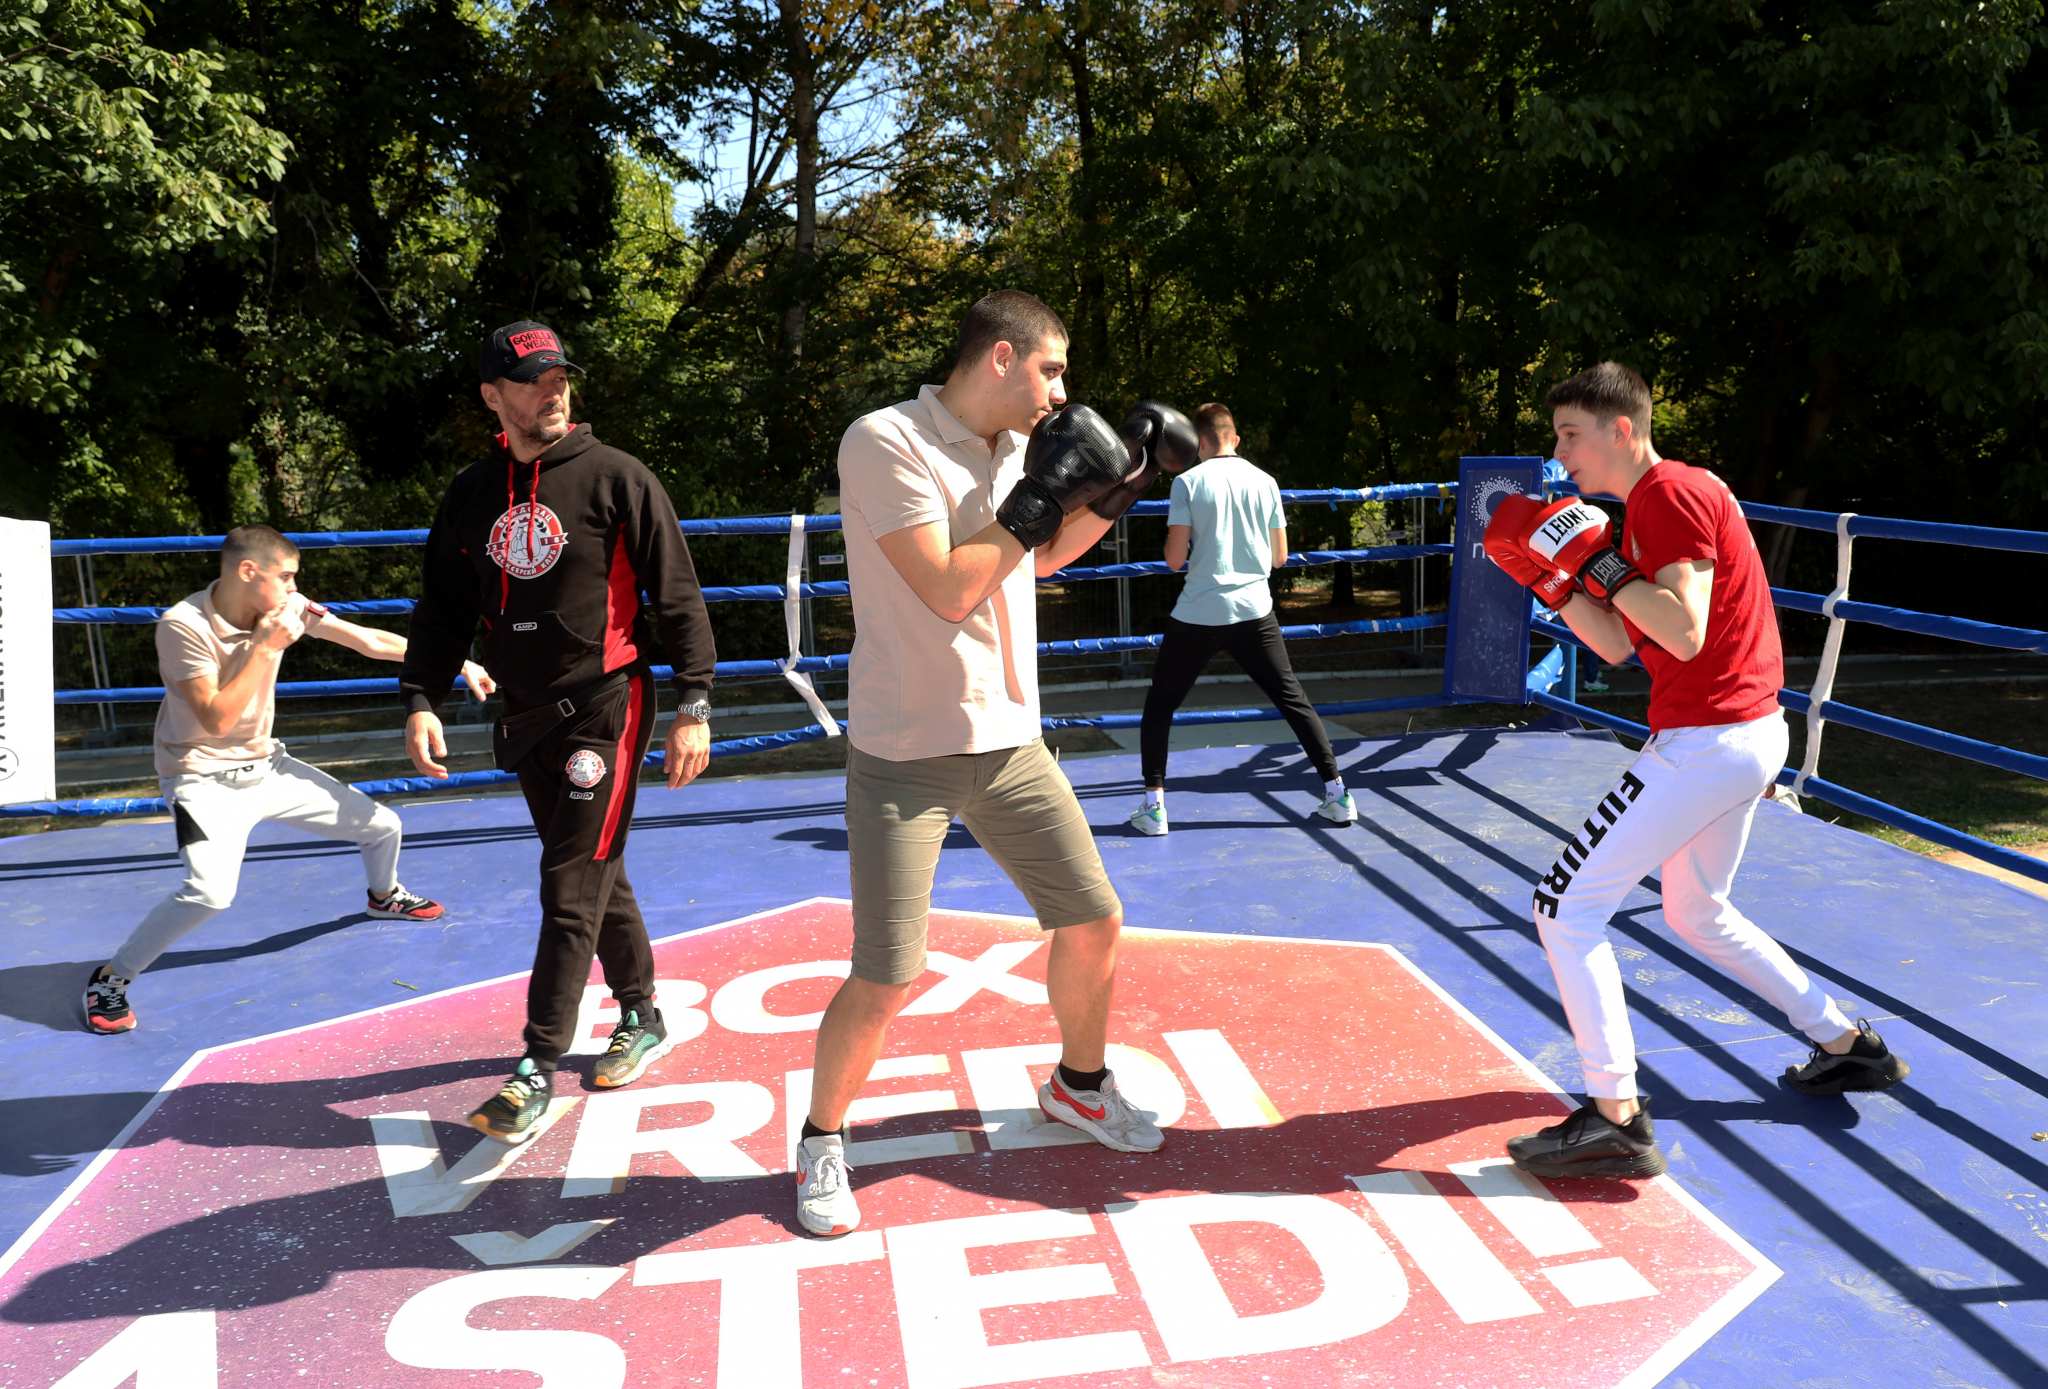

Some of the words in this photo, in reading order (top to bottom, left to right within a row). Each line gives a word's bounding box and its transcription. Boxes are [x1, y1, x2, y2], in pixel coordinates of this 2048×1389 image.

[513, 331, 554, 345] GORILLA
[523, 340, 553, 350] WEAR
[1541, 506, 1594, 546] LEONE
[540, 549, 557, 569] КЛУБ
[1590, 551, 1627, 586] LEONE
[1532, 770, 1646, 920] FUTURE
[560, 940, 1048, 1056] BOX
[369, 1028, 1286, 1218] VREDI
